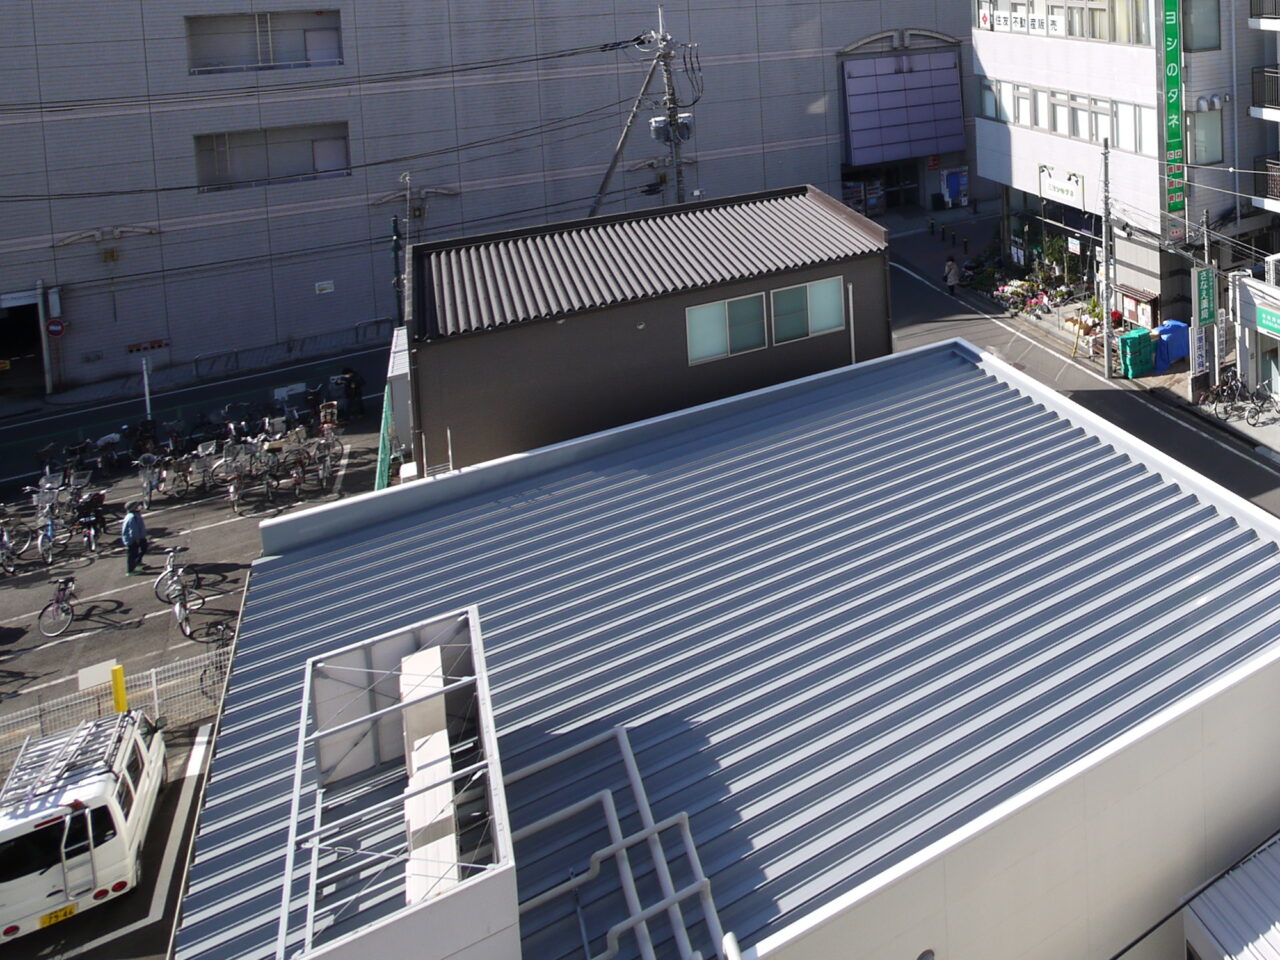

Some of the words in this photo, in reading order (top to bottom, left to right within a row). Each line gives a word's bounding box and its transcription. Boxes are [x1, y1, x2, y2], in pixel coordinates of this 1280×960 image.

[995, 15, 1058, 32] 住友不動産販売
[1200, 271, 1209, 319] さなえ薬局
